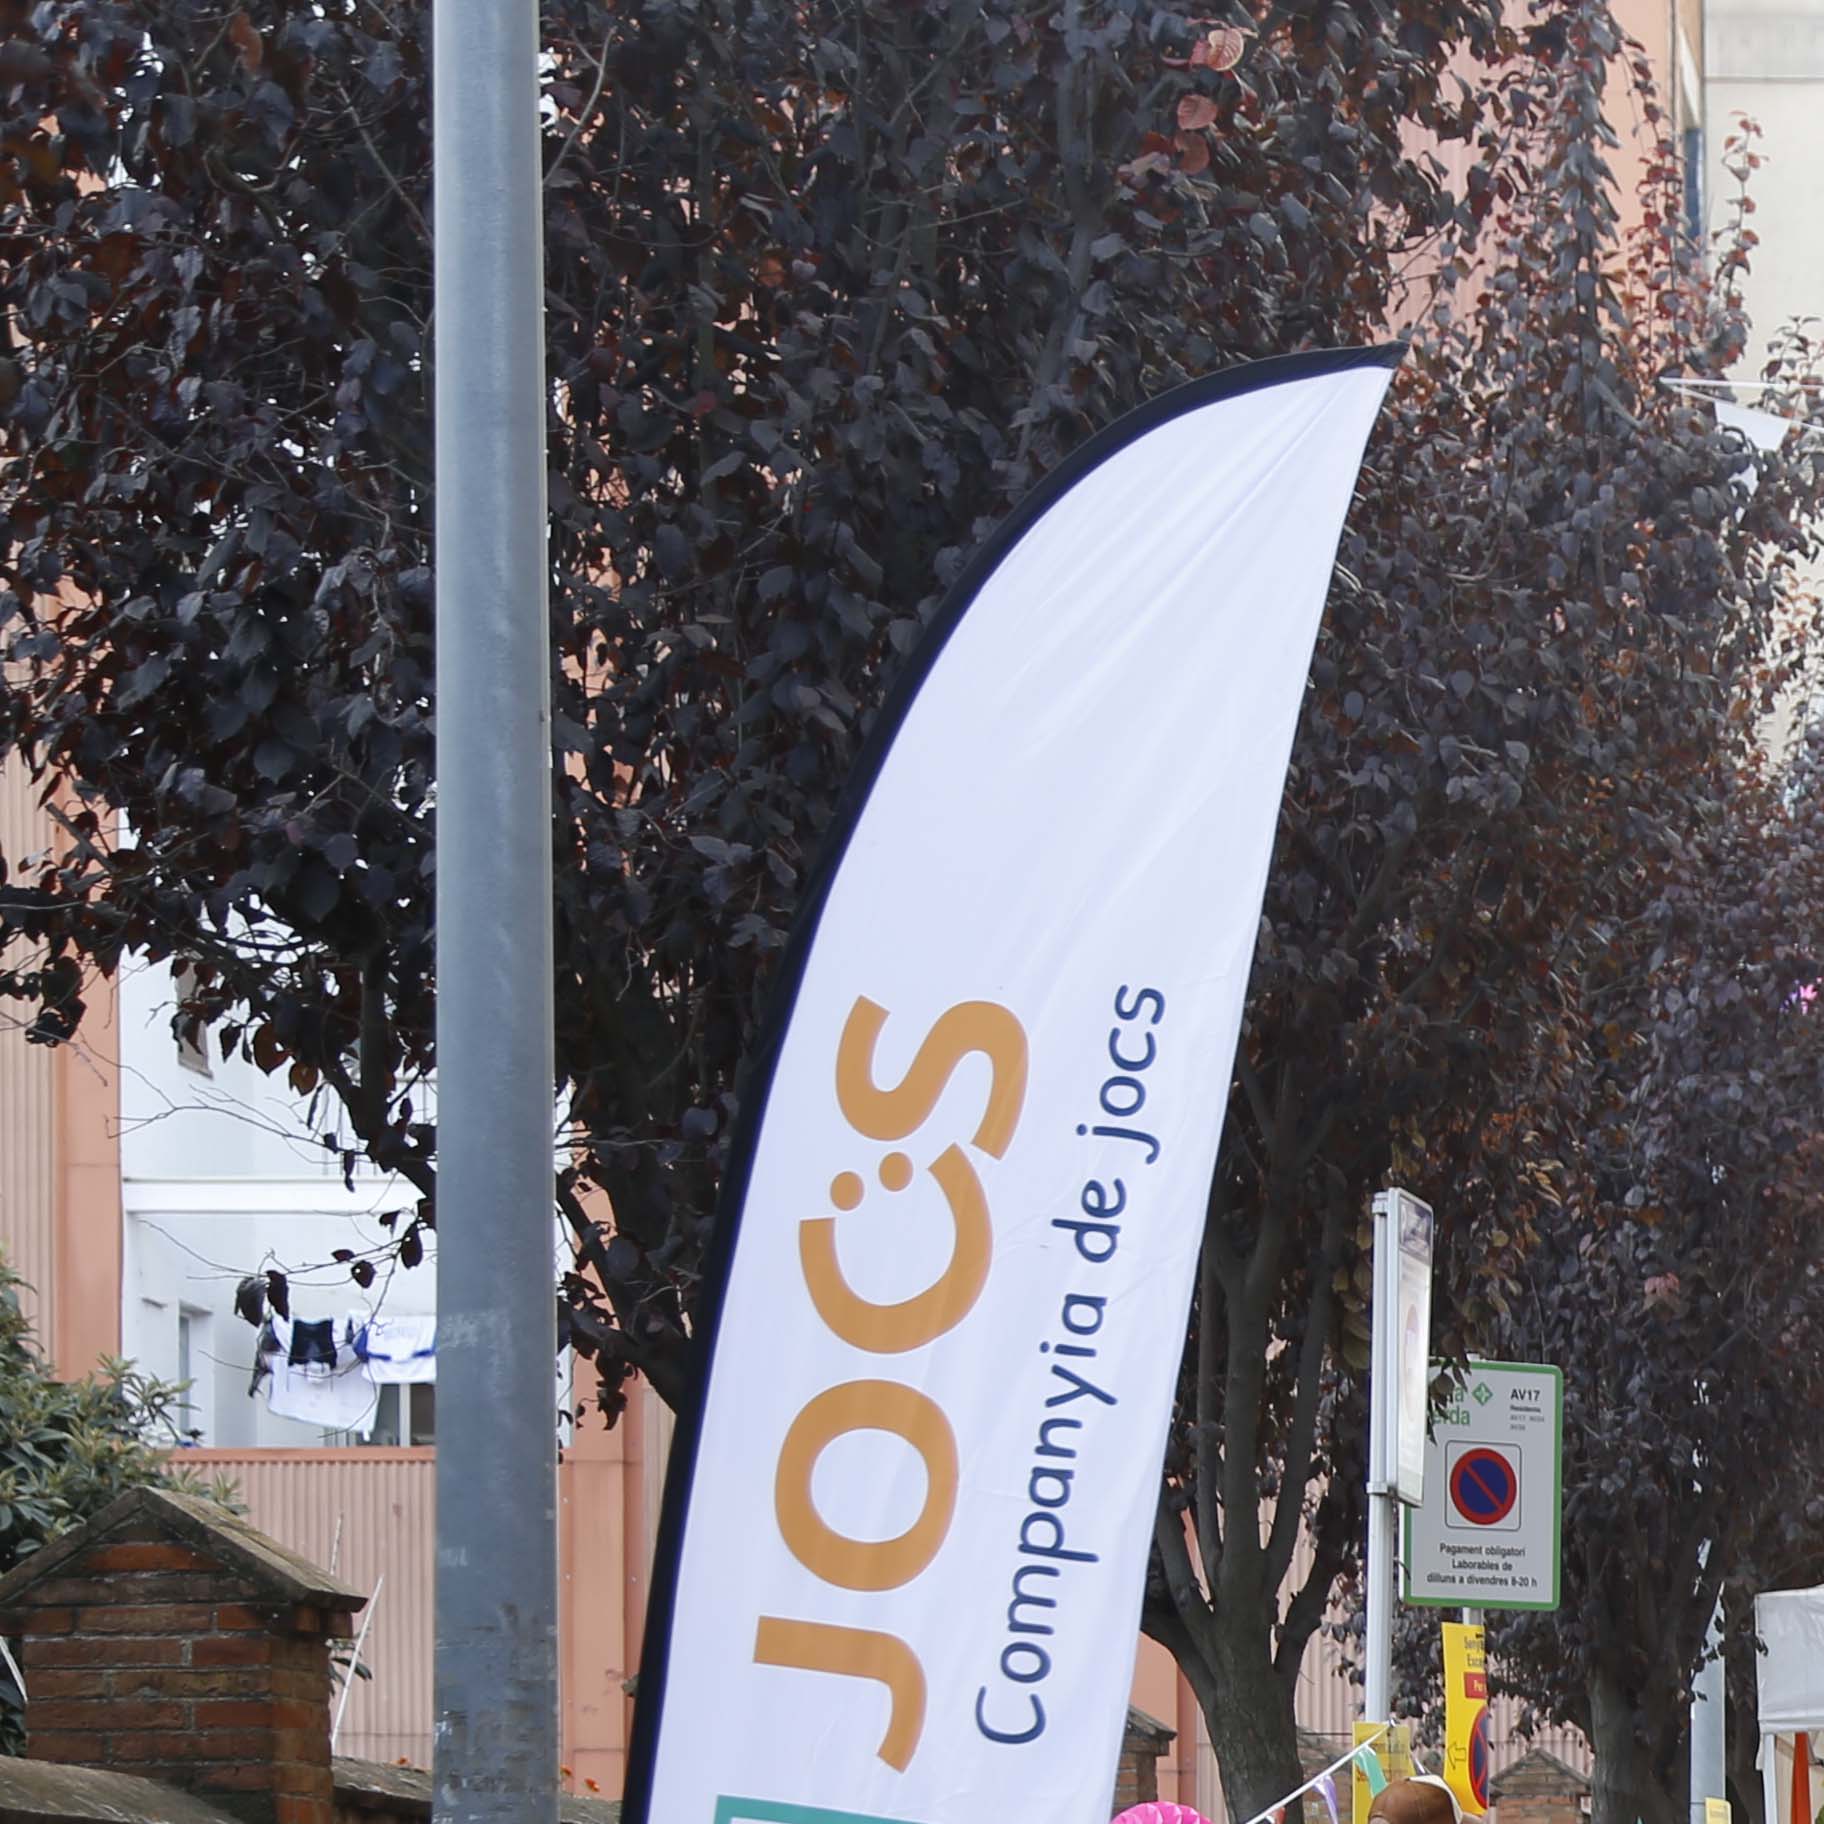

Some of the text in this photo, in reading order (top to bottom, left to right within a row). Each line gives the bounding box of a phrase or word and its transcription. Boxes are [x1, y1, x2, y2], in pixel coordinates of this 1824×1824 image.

[975, 984, 1166, 1745] Companyia de jocs
[752, 995, 1030, 1774] JOCS
[1510, 1388, 1540, 1401] AV17
[1440, 1542, 1526, 1558] Pagament obligatori
[1452, 1559, 1513, 1571] Laborables de
[1427, 1573, 1456, 1584] dilluns
[1466, 1574, 1508, 1586] divendres
